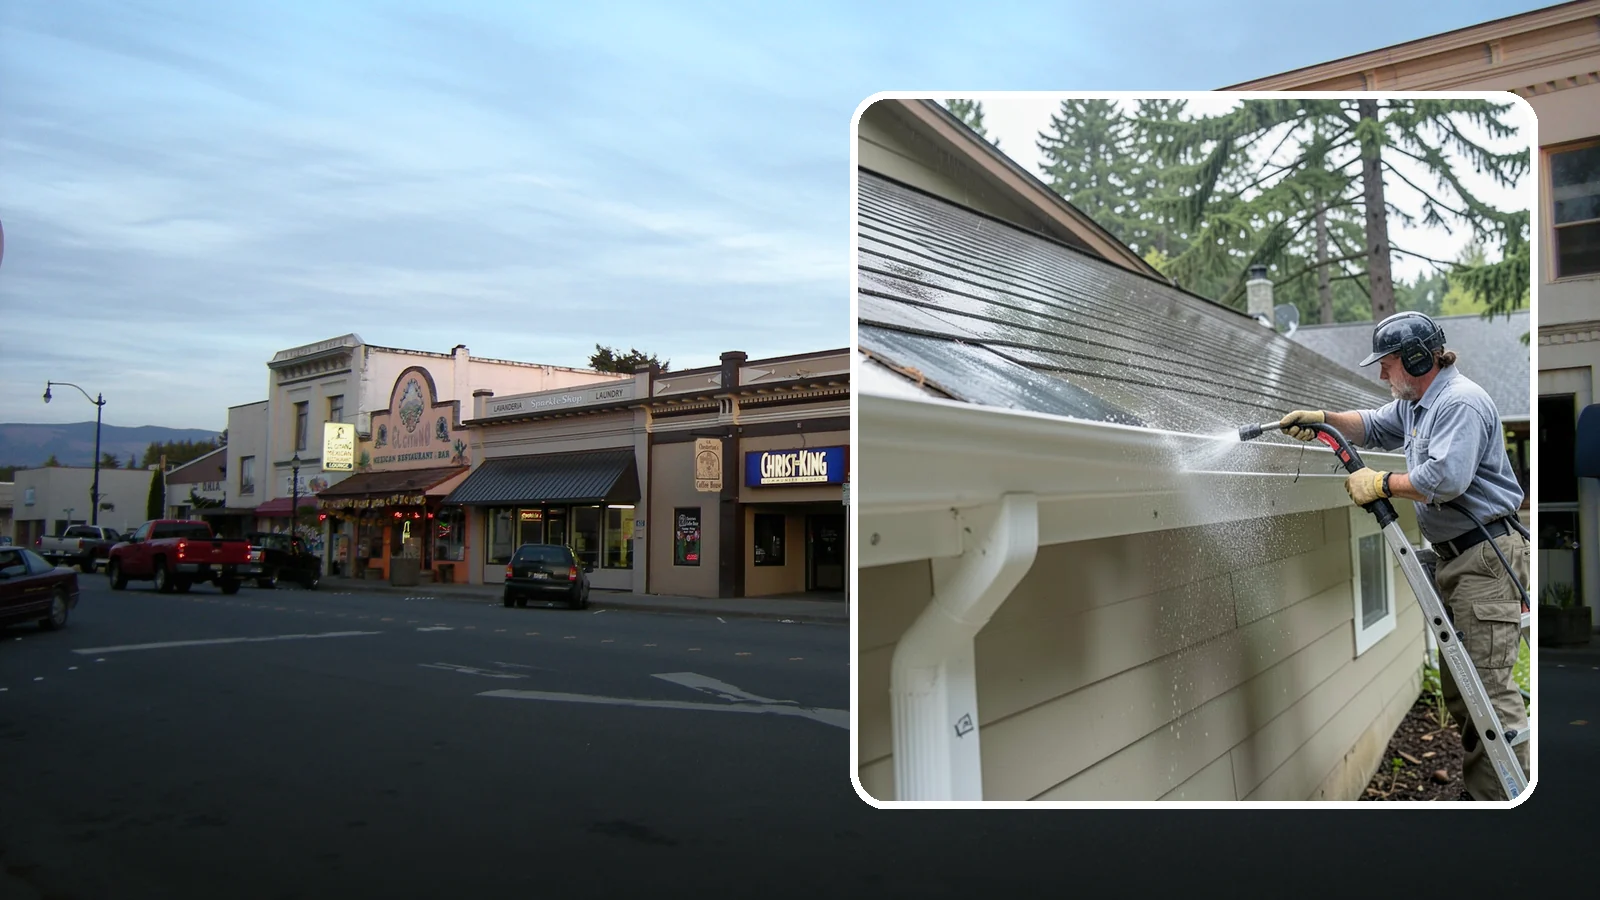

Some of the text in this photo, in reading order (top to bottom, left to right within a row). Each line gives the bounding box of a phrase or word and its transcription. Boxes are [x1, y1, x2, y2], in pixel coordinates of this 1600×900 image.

[493, 389, 623, 413] LAVANDERIA Sparkle Shop LAUNDRY
[373, 455, 396, 464] MEXICAN
[397, 451, 434, 462] RESTAURANT
[437, 450, 450, 459] BAR
[760, 450, 828, 478] CHRIST KING
[696, 480, 709, 489] Coffee
